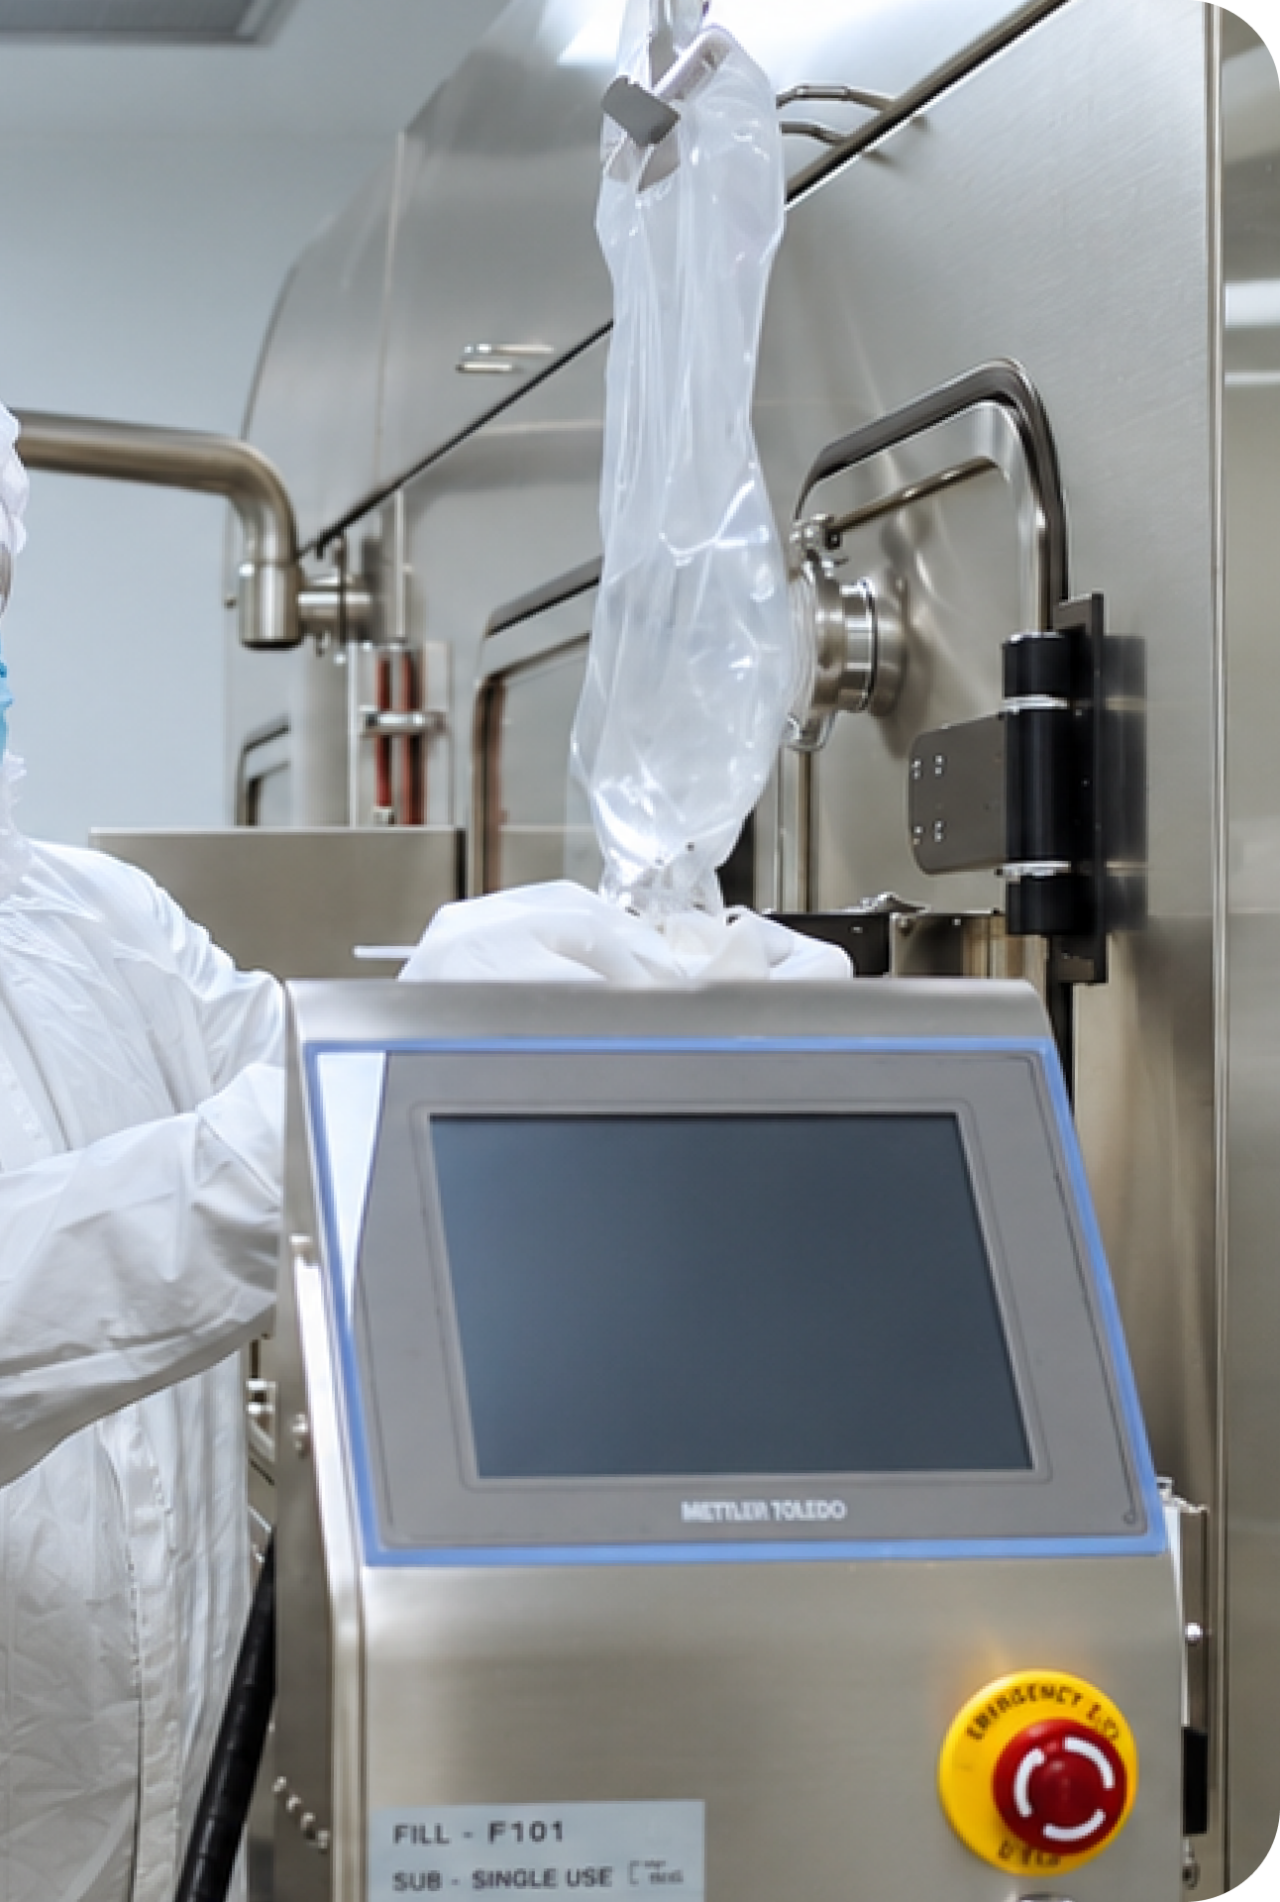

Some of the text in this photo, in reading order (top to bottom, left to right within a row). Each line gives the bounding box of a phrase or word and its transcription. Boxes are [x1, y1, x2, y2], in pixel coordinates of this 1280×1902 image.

[770, 1498, 848, 1522] TOLEDO
[392, 1822, 451, 1846] FILL
[487, 1819, 565, 1845] F101
[392, 1869, 443, 1892] SUB
[471, 1867, 559, 1891] SINGLE
[566, 1866, 614, 1888] USE
